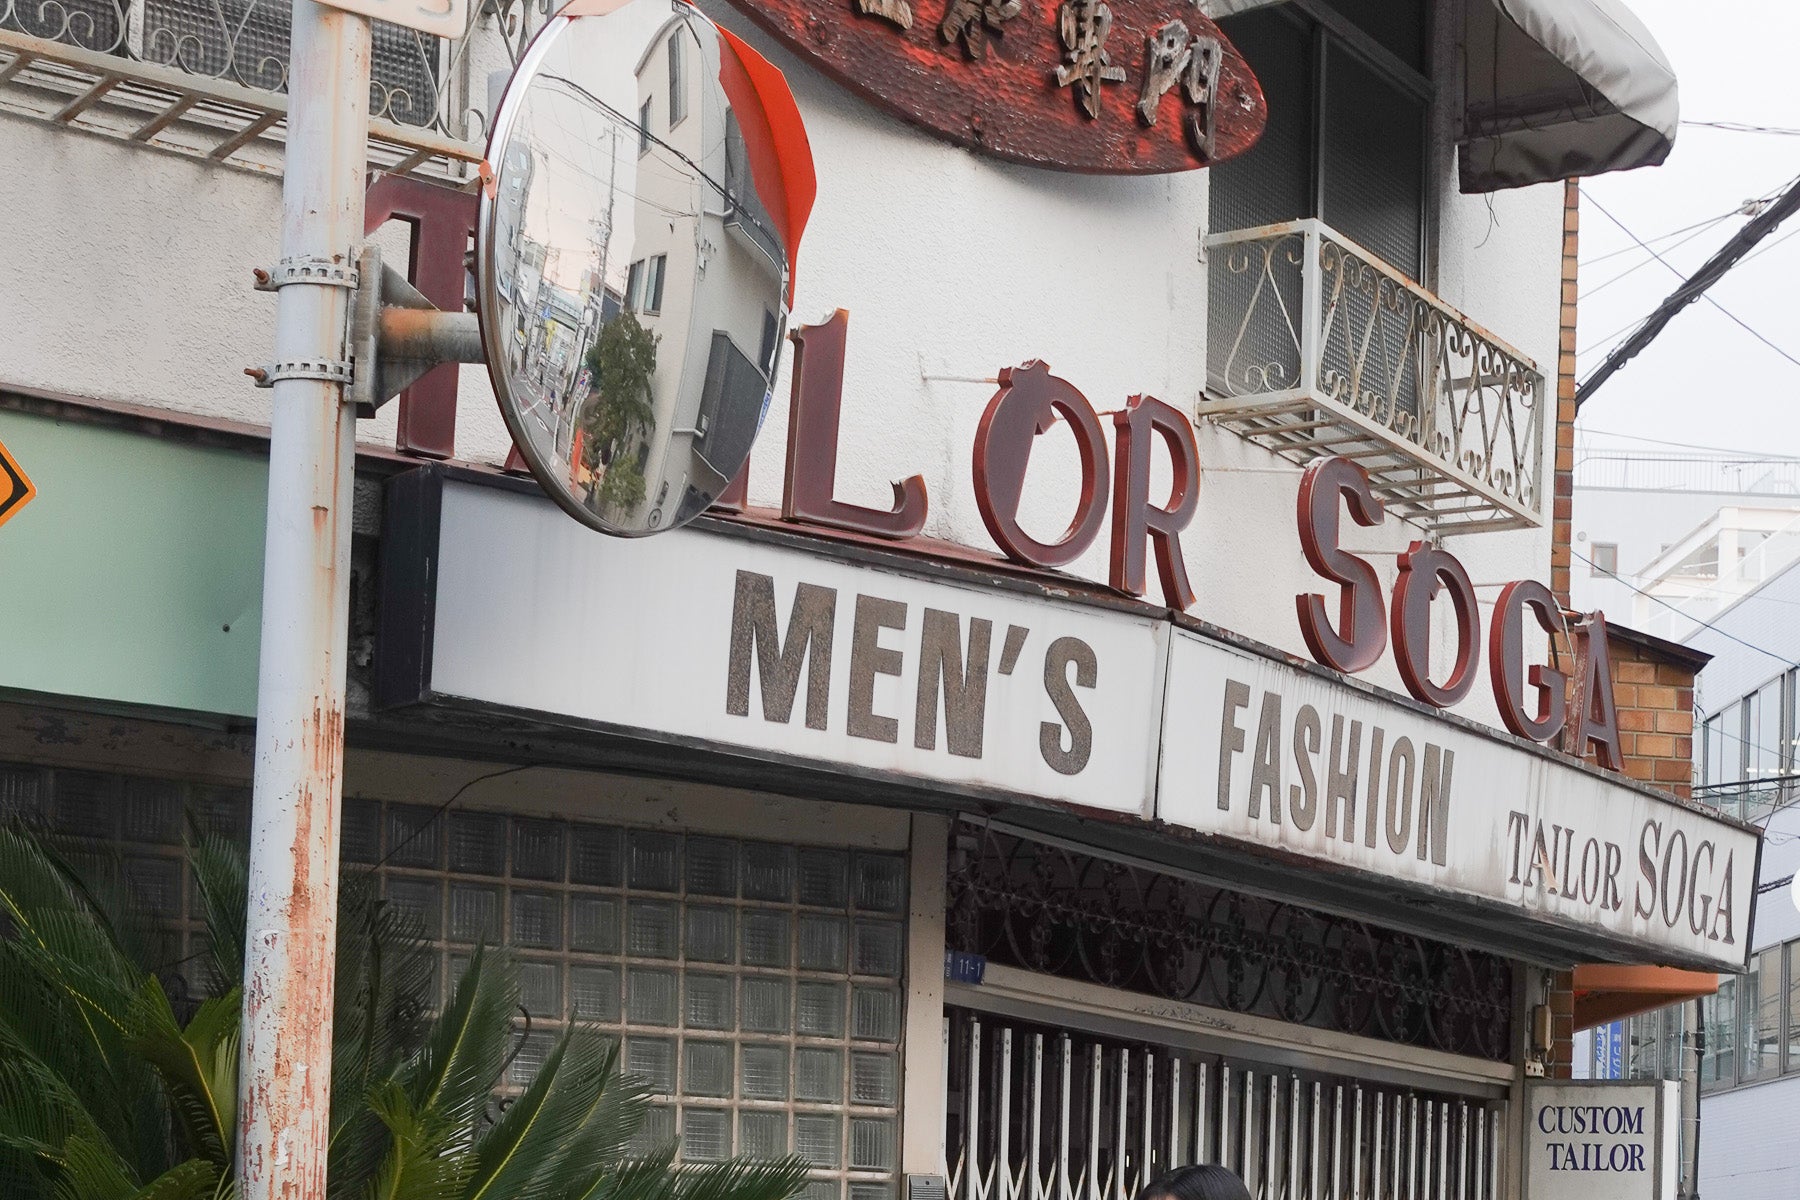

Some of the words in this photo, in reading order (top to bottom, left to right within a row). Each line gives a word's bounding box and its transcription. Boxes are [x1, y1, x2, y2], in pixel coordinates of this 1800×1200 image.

[364, 168, 1201, 610] TLOR
[1296, 456, 1624, 771] SOGA
[726, 569, 1098, 776] MEN'S
[1217, 678, 1454, 867] FASHION
[1507, 811, 1623, 912] TAILOR
[1634, 818, 1735, 945] SOGA
[1538, 1105, 1645, 1135] CUSTOM
[1546, 1142, 1646, 1172] TAILOR
